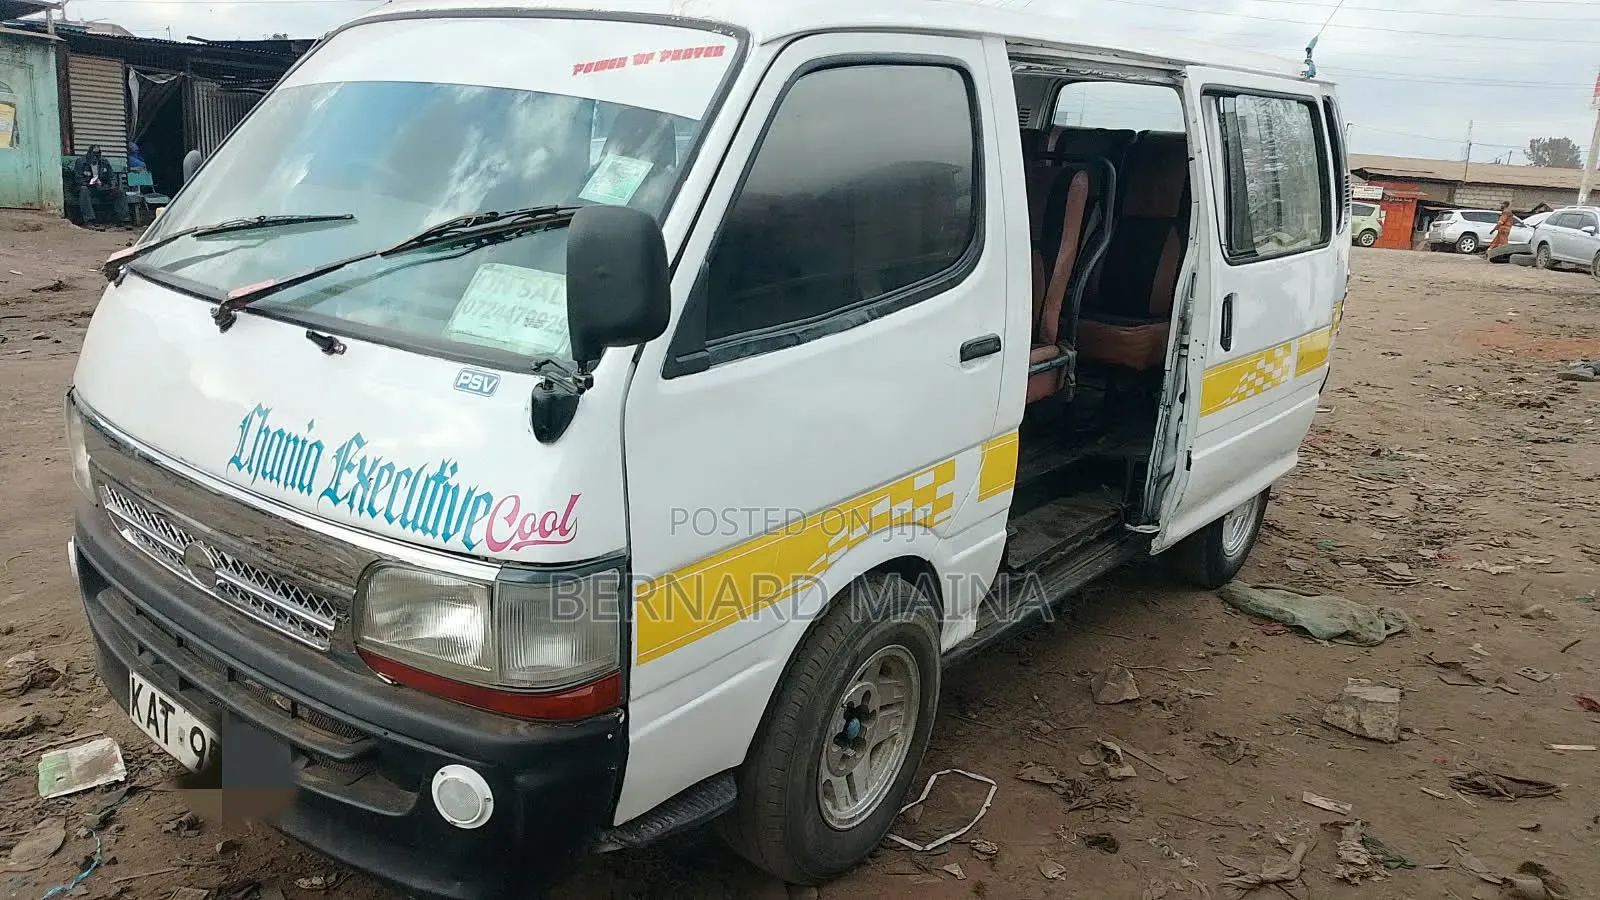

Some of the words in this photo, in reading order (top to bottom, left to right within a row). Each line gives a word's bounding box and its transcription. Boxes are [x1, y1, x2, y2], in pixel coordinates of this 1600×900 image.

[457, 371, 498, 393] PSV
[317, 432, 493, 551] Executive
[485, 493, 582, 552] Cool
[131, 677, 176, 746] KAT
